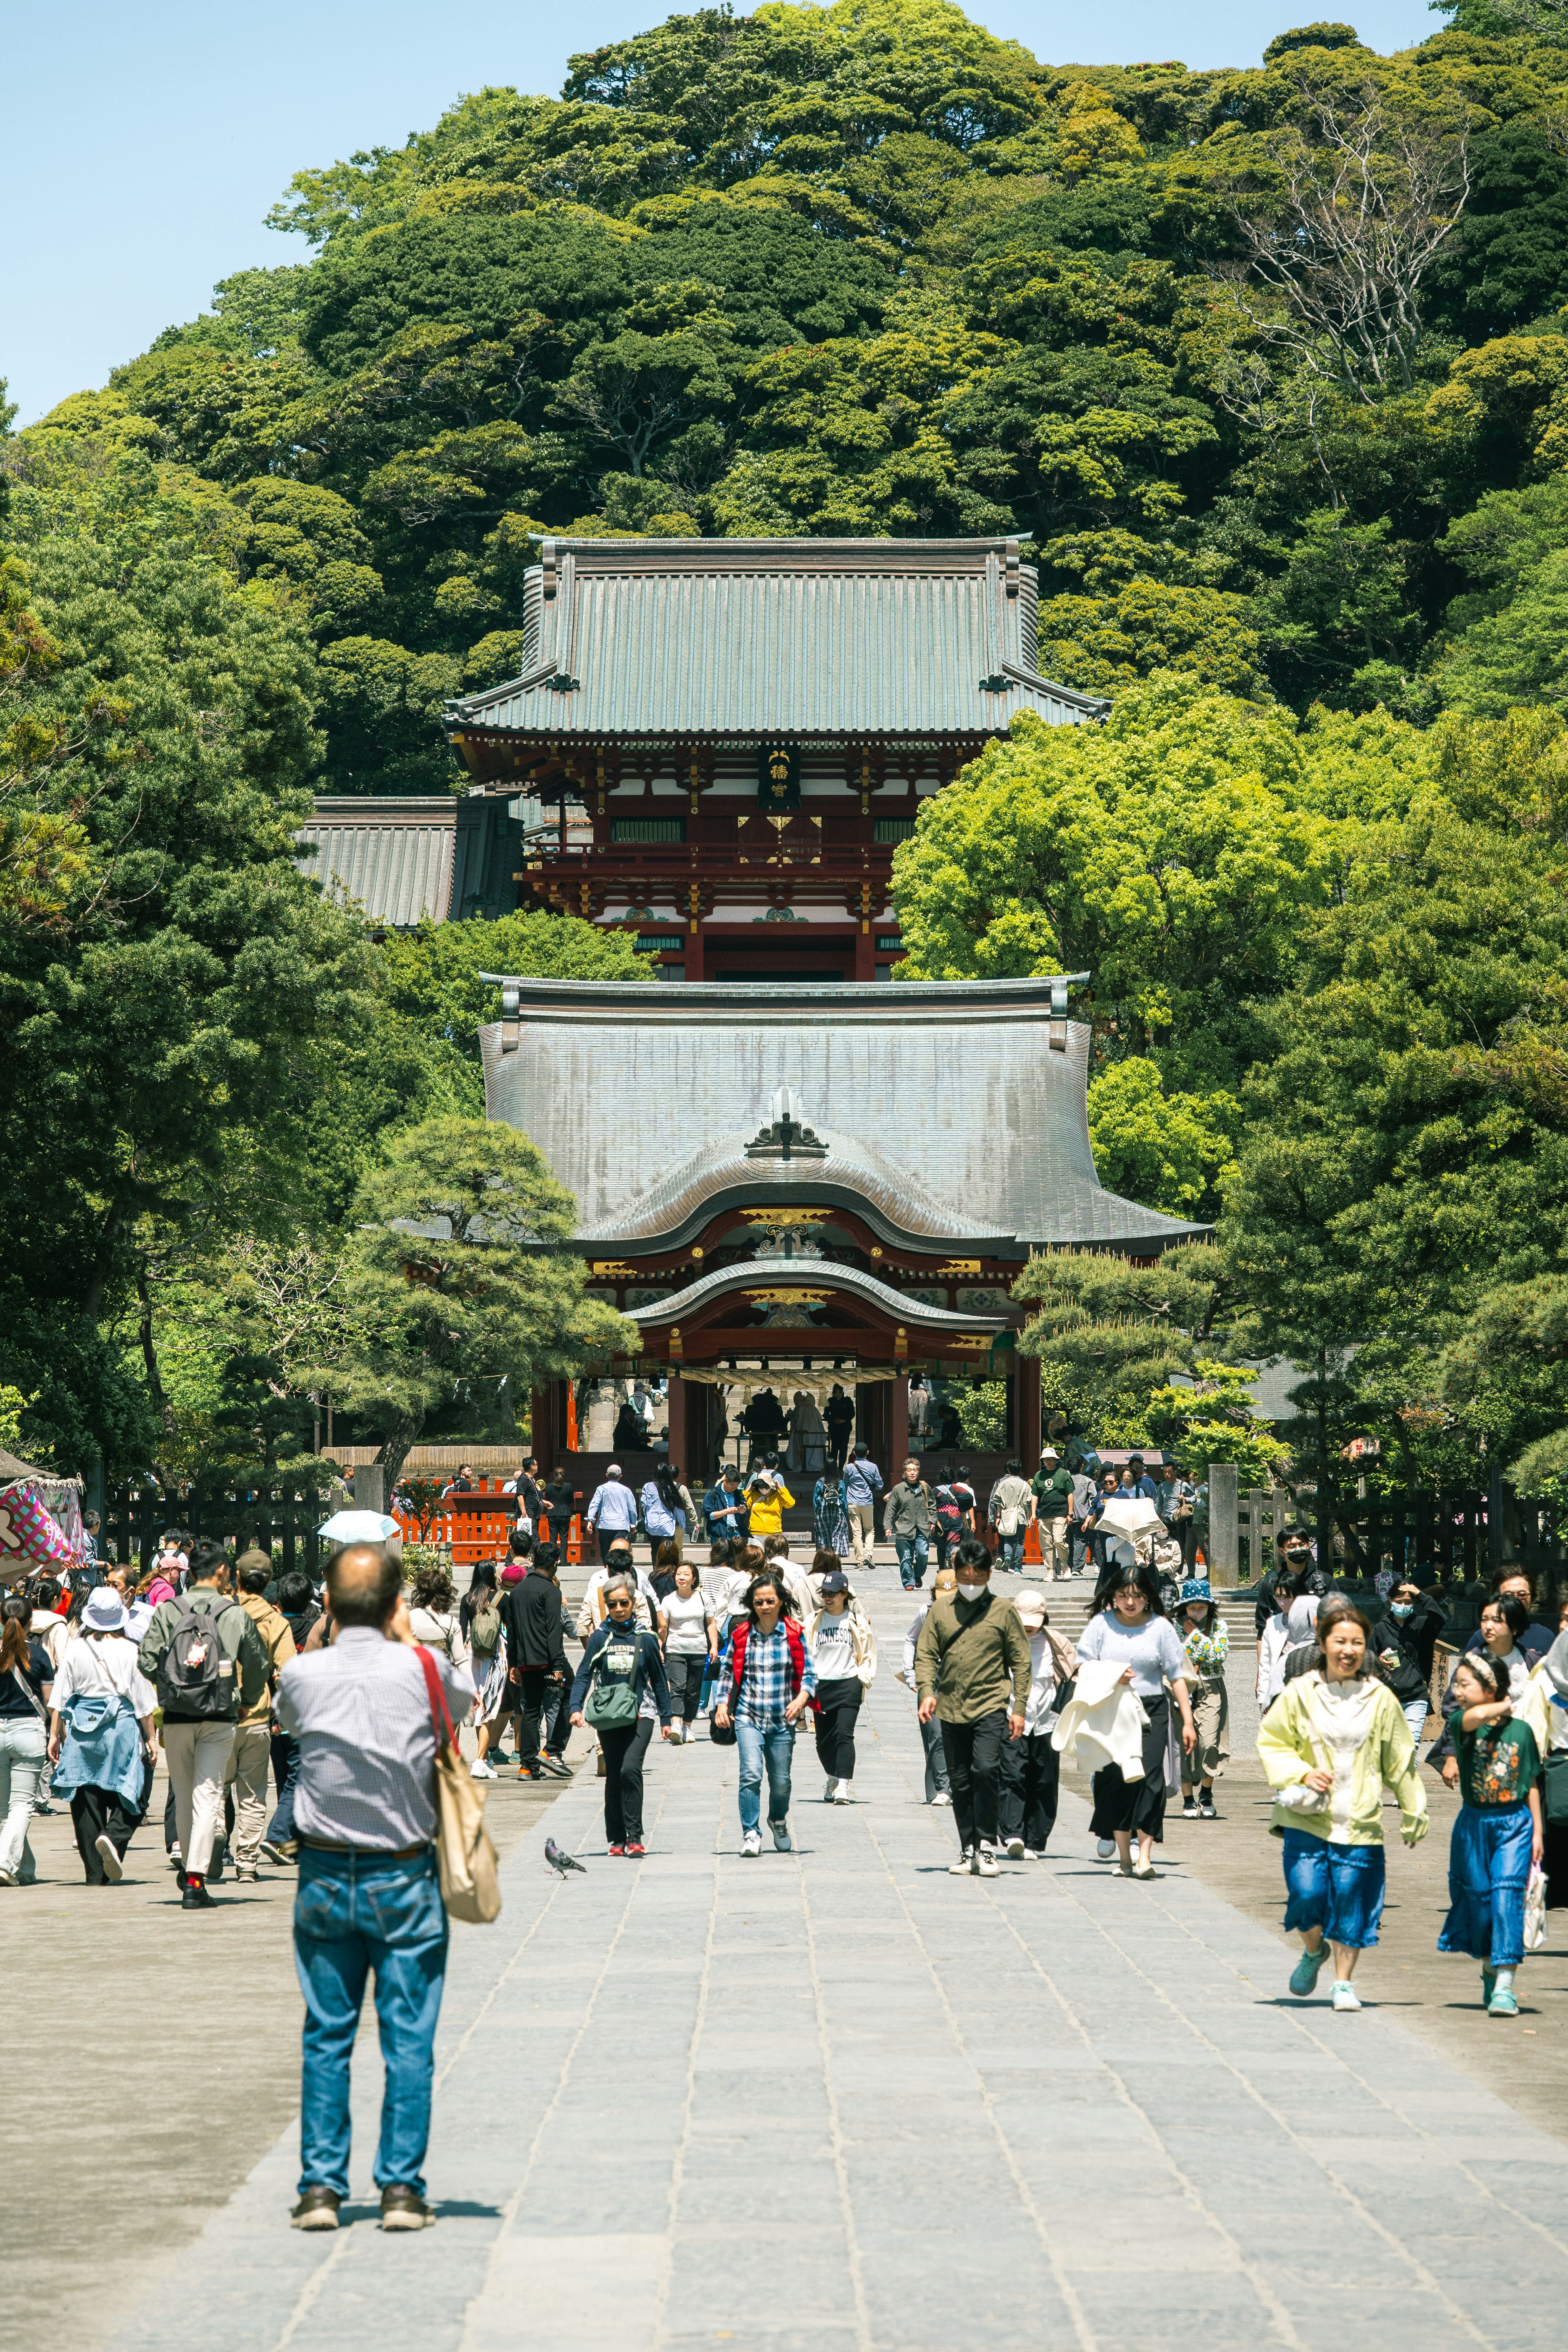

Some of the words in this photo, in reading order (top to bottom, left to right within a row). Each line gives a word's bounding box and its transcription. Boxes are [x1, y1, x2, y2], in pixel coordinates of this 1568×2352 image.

[768, 750, 790, 798] 八幡宮
[943, 1581, 951, 1590] NY
[606, 1645, 643, 1653] GREENER
